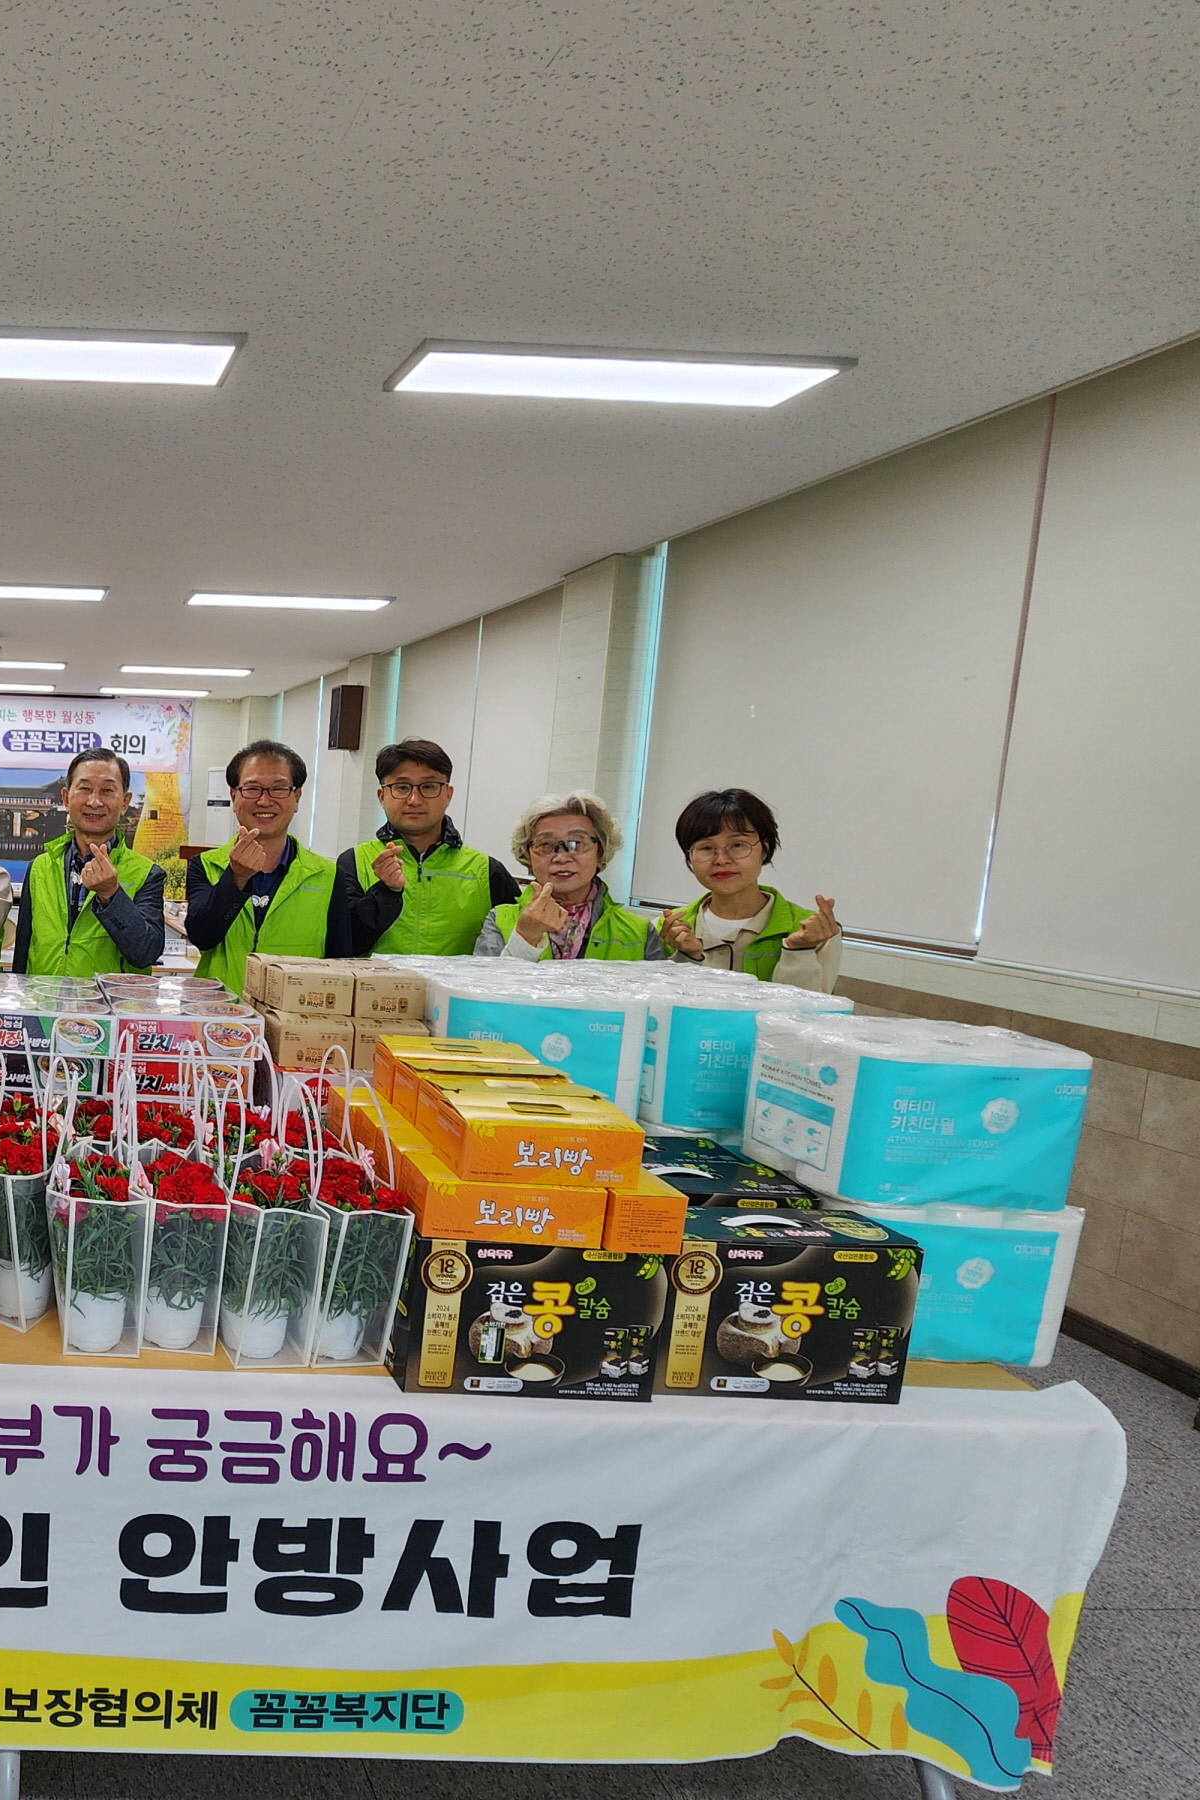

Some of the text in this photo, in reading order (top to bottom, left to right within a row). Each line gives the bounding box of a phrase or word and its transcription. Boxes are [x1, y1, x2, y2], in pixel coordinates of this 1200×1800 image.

[22, 709, 57, 723] 행복한
[8, 730, 96, 752] 꼼꼼복지단
[110, 733, 146, 755] 회의
[3, 1020, 23, 1029] 농심
[137, 1033, 175, 1052] 김치
[468, 1030, 504, 1042] 애터미
[700, 1039, 736, 1052] 애터미
[761, 1063, 780, 1073] ATOMY
[780, 1069, 803, 1081] KITCHEN
[803, 1077, 822, 1089] TOWEL
[892, 1098, 937, 1116] 애터미
[890, 1115, 956, 1136] 키친타월
[887, 1136, 1001, 1149] ATOMY KITCHEN TOWEL
[512, 1140, 594, 1176] 보리빵
[474, 1199, 555, 1235] 보리빵
[477, 1248, 514, 1260] 삼육두유
[727, 1249, 764, 1260] 삼육두유
[439, 1259, 455, 1274] 18
[688, 1259, 704, 1275] 18
[427, 1312, 447, 1320] 소비자가
[436, 1304, 450, 1312] 2024
[485, 1280, 577, 1340] 검은 콩
[577, 1297, 613, 1320] 칼슘
[675, 1313, 696, 1321] 소비자가
[735, 1280, 825, 1339] 검은 콩
[826, 1297, 862, 1321] 칼슘
[426, 1329, 442, 1337] 브랜드
[146, 1408, 492, 1484] 궁금해요~
[118, 1513, 643, 1618] 안방사업
[249, 1691, 451, 1731] 꼼꼼복지단
